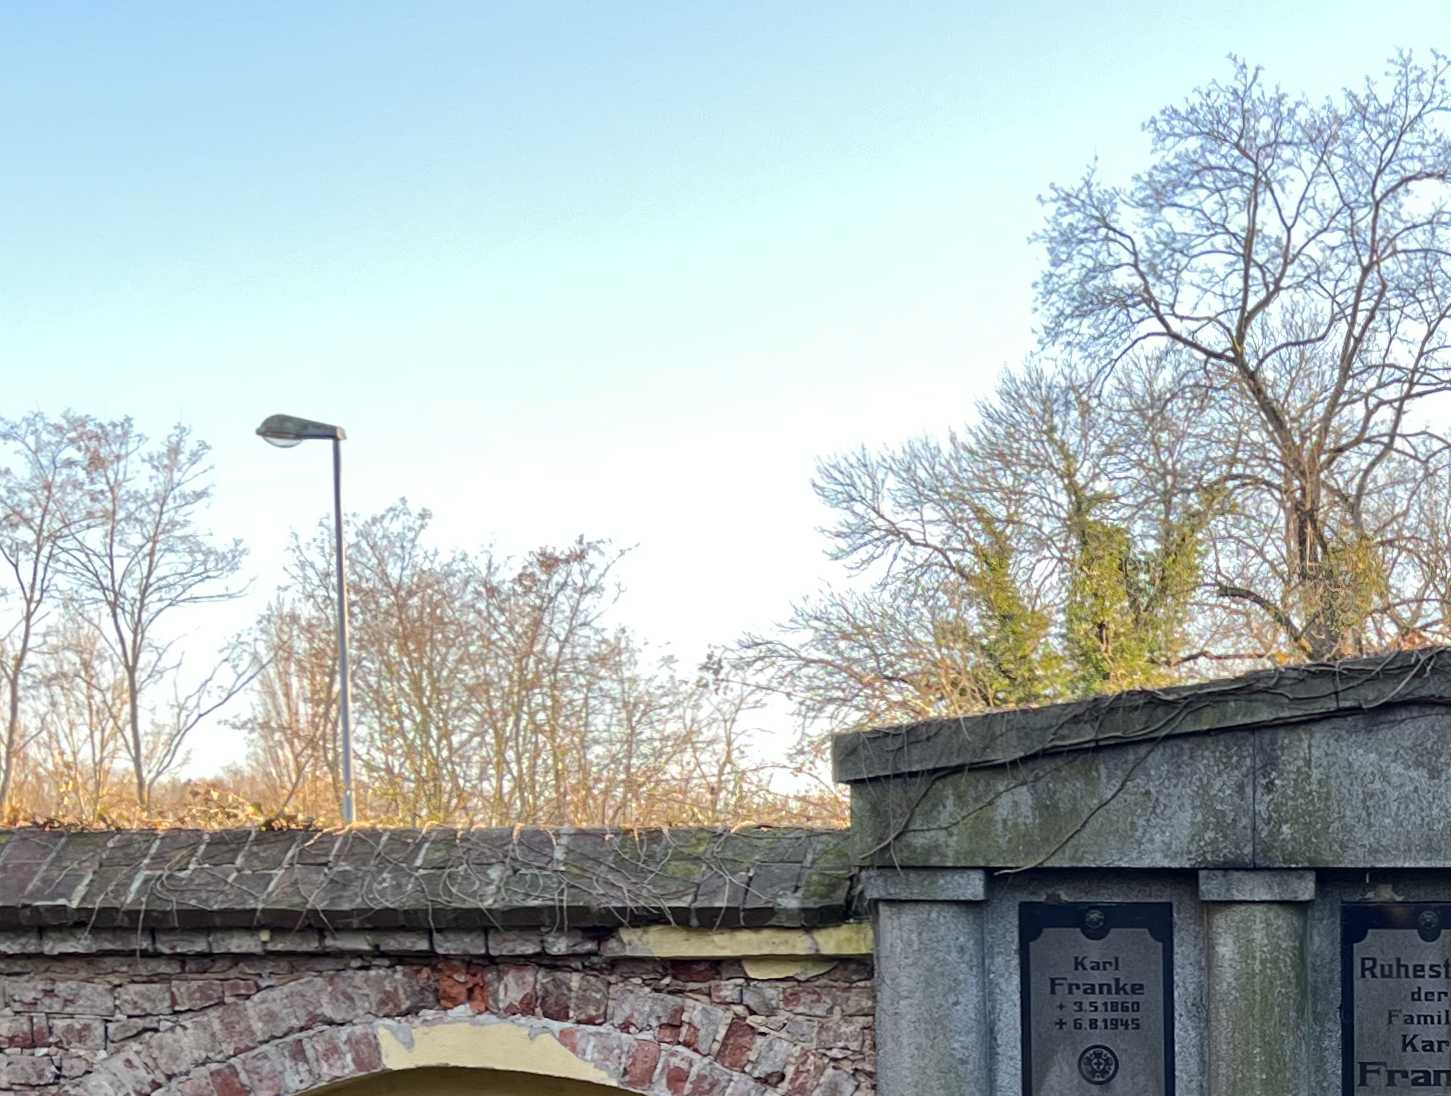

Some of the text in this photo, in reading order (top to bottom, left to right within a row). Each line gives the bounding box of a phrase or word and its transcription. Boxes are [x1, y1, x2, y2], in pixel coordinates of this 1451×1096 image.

[1072, 955, 1121, 972] Karl
[1048, 976, 1145, 995] Franke
[1410, 986, 1449, 1002] der
